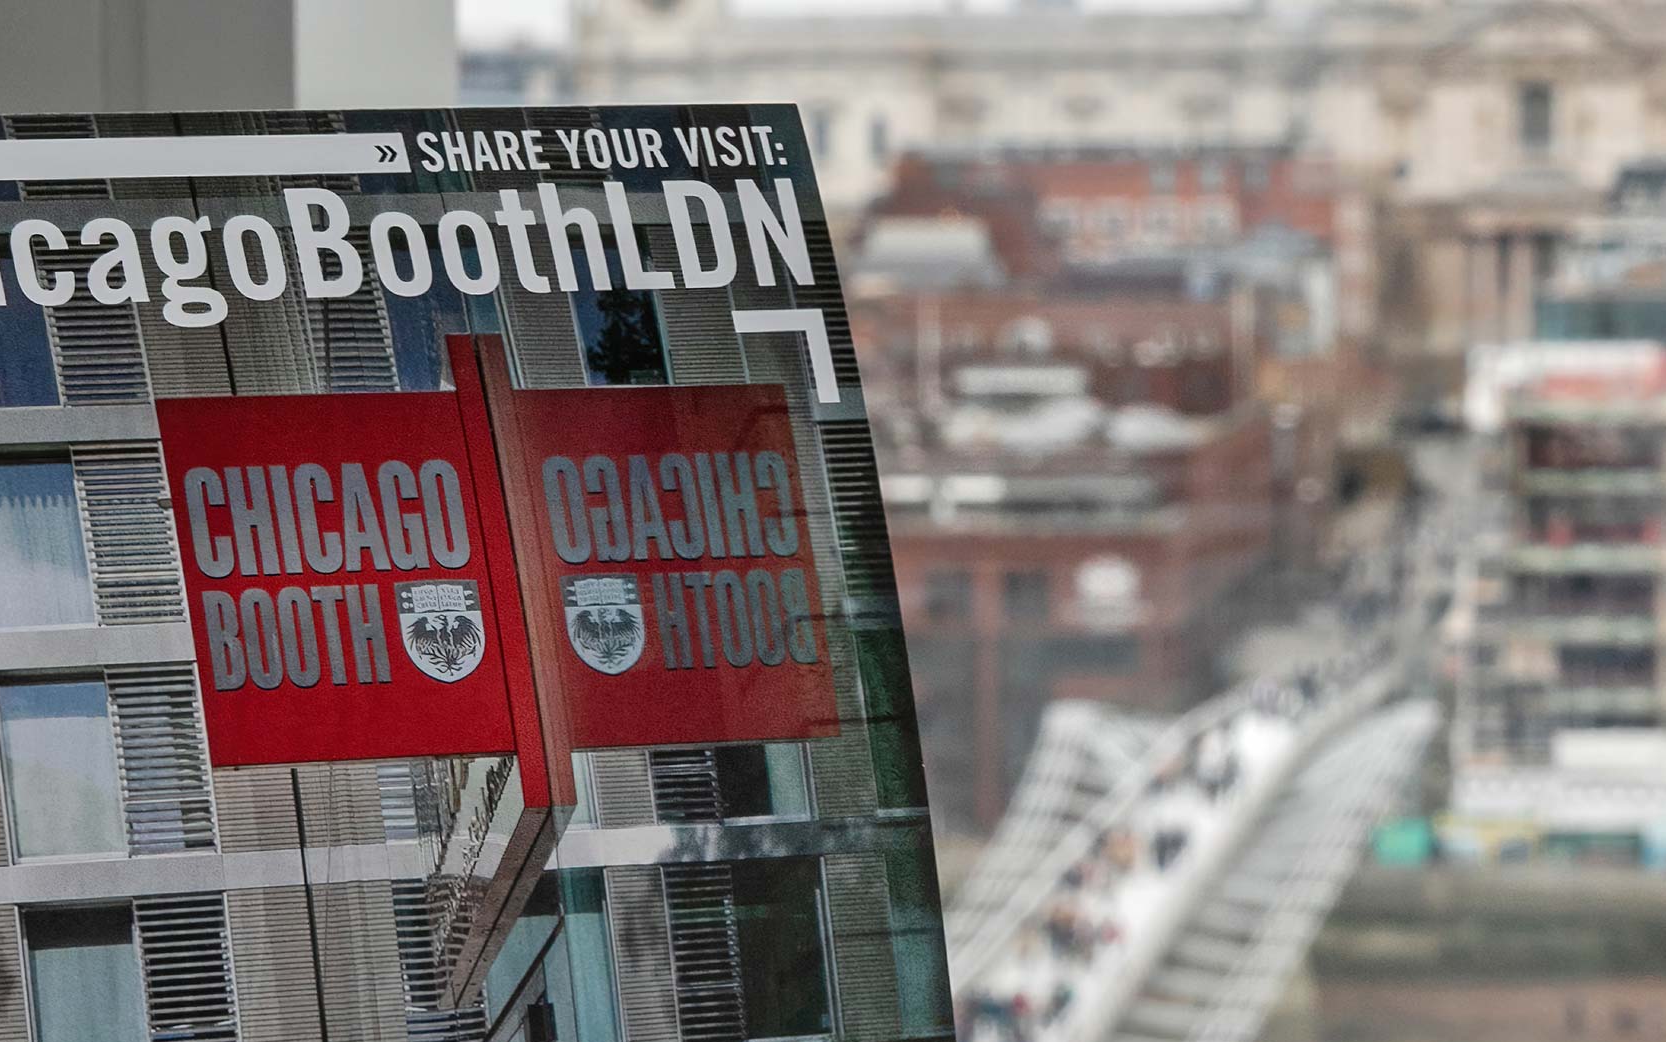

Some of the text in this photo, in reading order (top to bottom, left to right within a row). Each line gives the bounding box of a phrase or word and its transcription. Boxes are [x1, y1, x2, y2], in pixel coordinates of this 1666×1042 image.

[417, 125, 788, 172] SHARE YOUR VISIT:
[183, 459, 471, 579] CHICAGO
[202, 584, 392, 691] BOOTH
